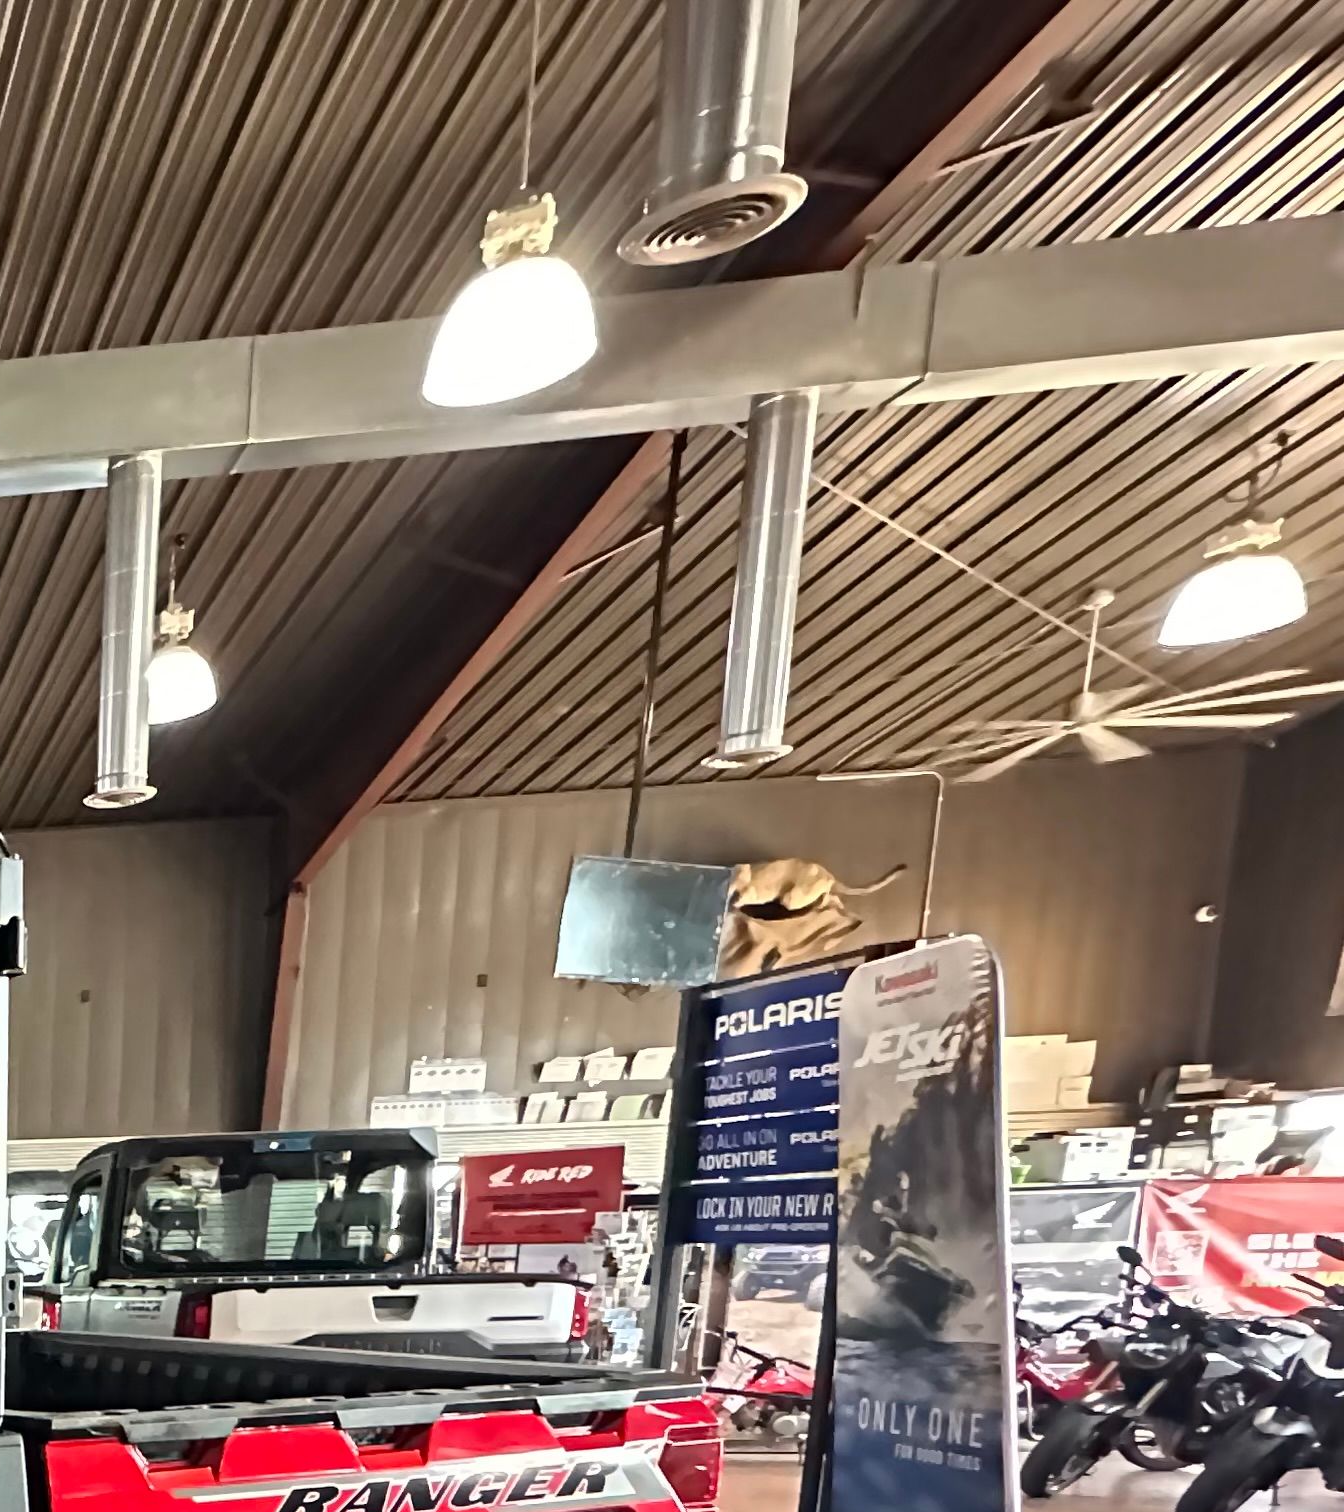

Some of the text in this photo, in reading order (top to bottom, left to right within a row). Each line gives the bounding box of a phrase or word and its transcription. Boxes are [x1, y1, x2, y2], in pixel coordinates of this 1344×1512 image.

[714, 991, 843, 1041] POLARIS
[746, 1066, 777, 1086] YOUR
[716, 1133, 740, 1150] ALL
[697, 1149, 777, 1171] ADVENTURE
[696, 1197, 727, 1220] LOCK
[728, 1196, 745, 1219] IN
[747, 1195, 782, 1218] YOUR
[784, 1194, 820, 1217] NEW
[858, 1397, 984, 1448] ONLY ONE
